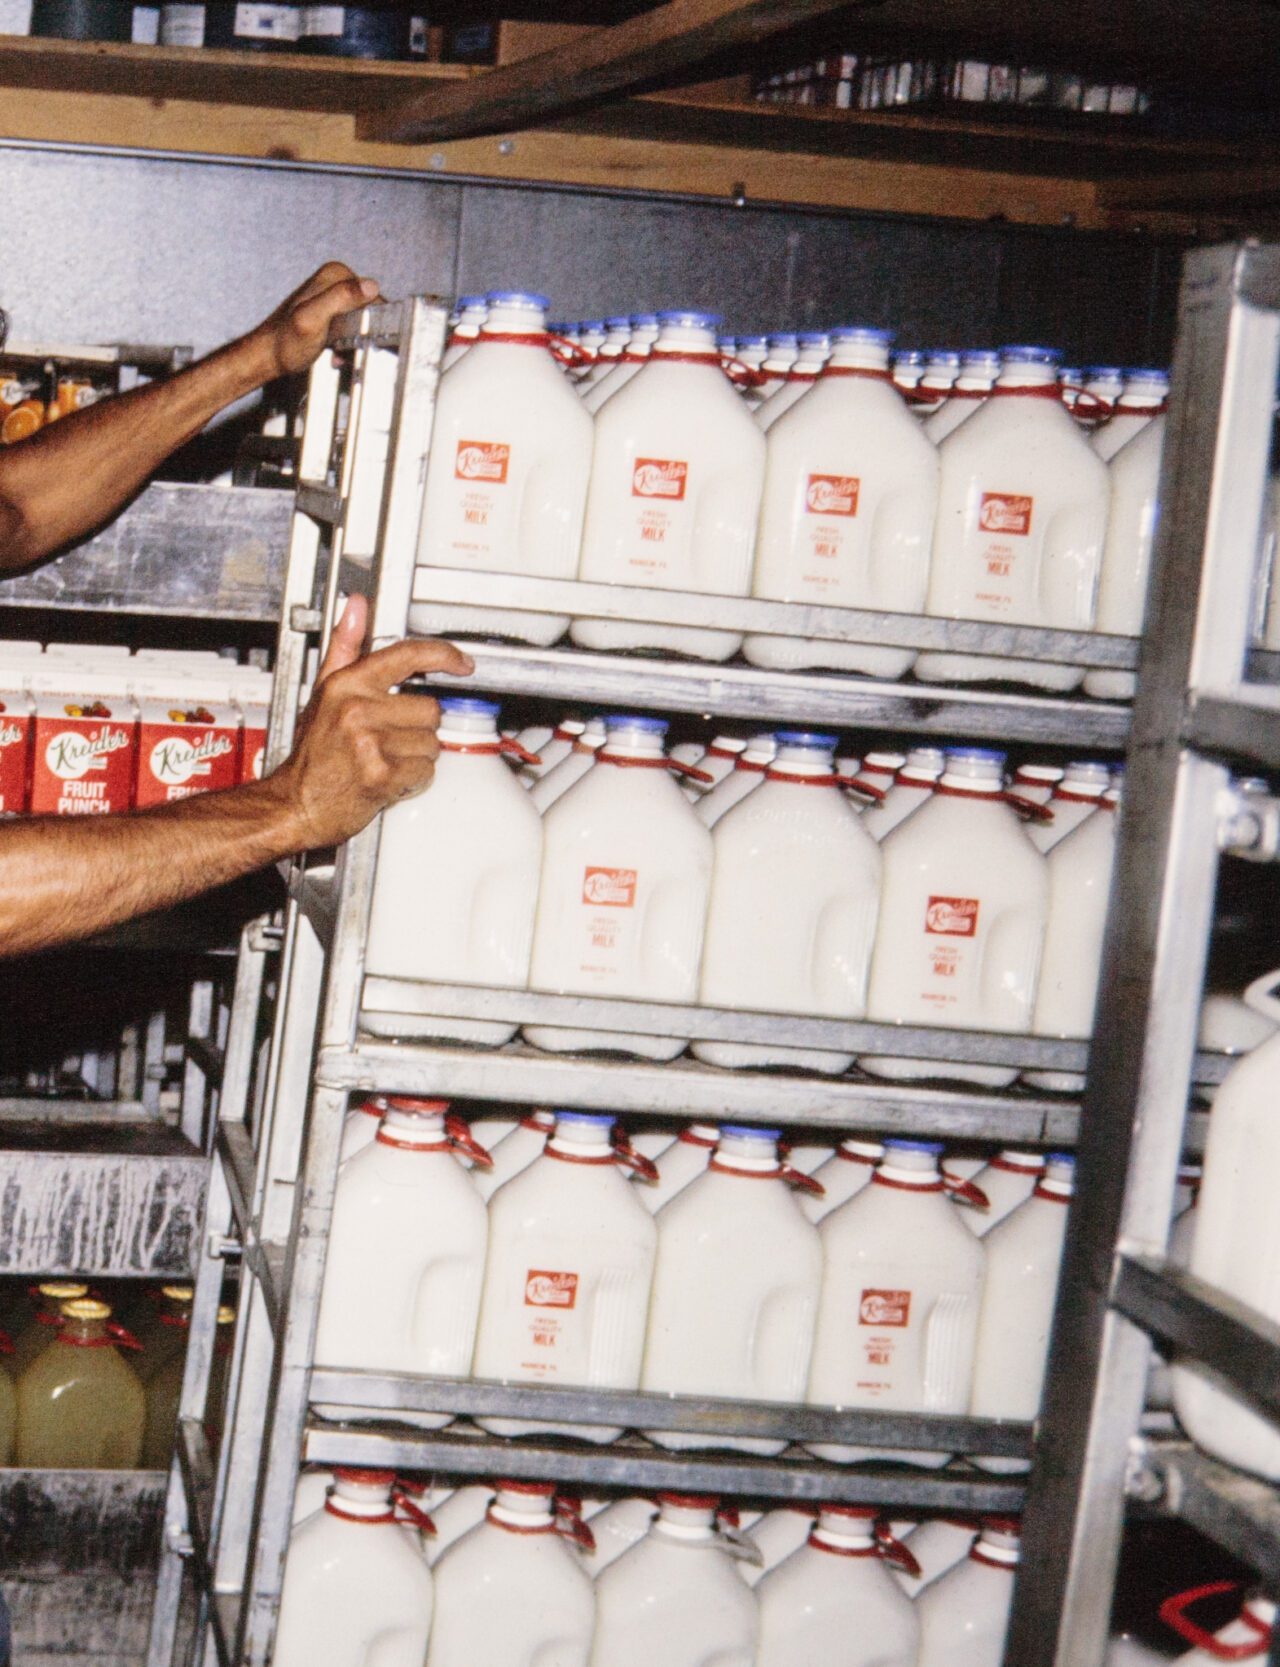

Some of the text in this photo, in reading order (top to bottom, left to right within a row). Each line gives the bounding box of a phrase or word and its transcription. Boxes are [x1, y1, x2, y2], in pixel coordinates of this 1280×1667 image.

[464, 509, 487, 525] MILK
[642, 527, 665, 542] MILK
[815, 543, 837, 557] MILK
[988, 561, 1010, 576] MILK
[51, 726, 128, 770] Kreider
[155, 731, 231, 776] Kreider
[63, 781, 107, 798] FRUIT
[58, 797, 110, 814] PUNCH
[592, 934, 615, 948] MILK
[934, 962, 955, 976] MILK
[534, 1333, 555, 1346] MILK
[869, 1353, 889, 1365] MILK
